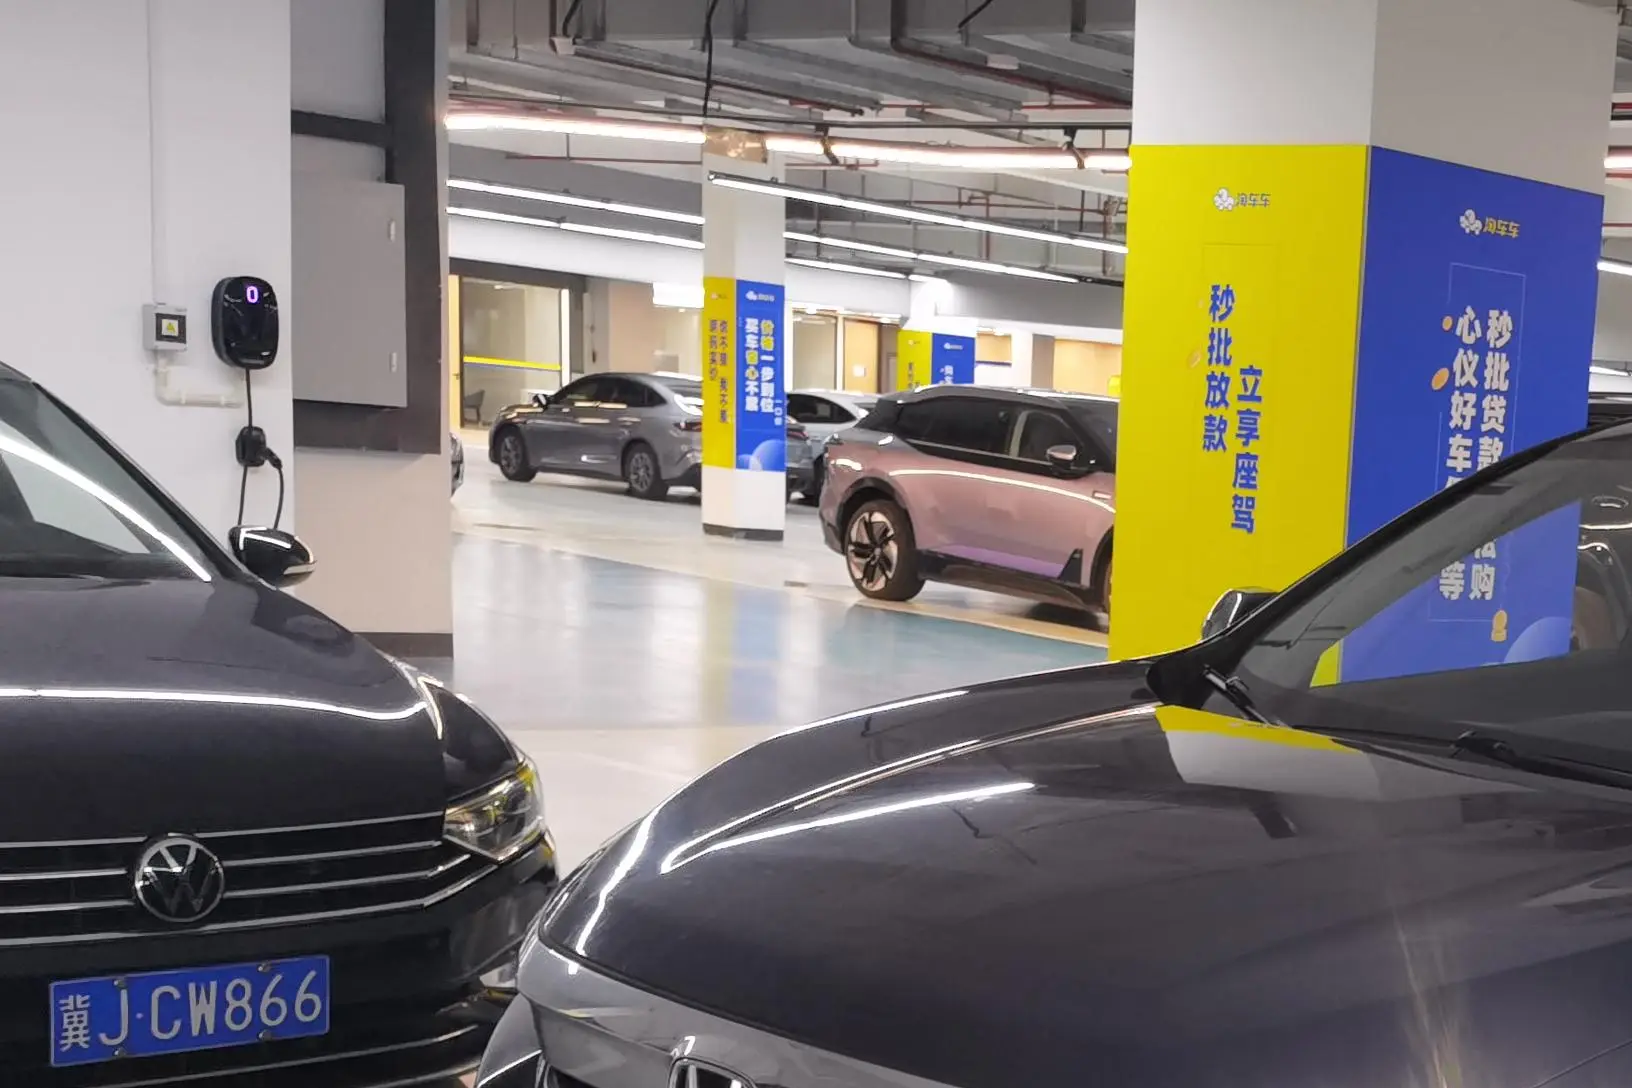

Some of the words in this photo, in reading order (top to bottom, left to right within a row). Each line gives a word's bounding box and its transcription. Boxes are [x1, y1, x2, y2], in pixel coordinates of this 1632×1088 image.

[1203, 284, 1236, 453] 秒批放款
[1231, 365, 1263, 535] 立享座驾
